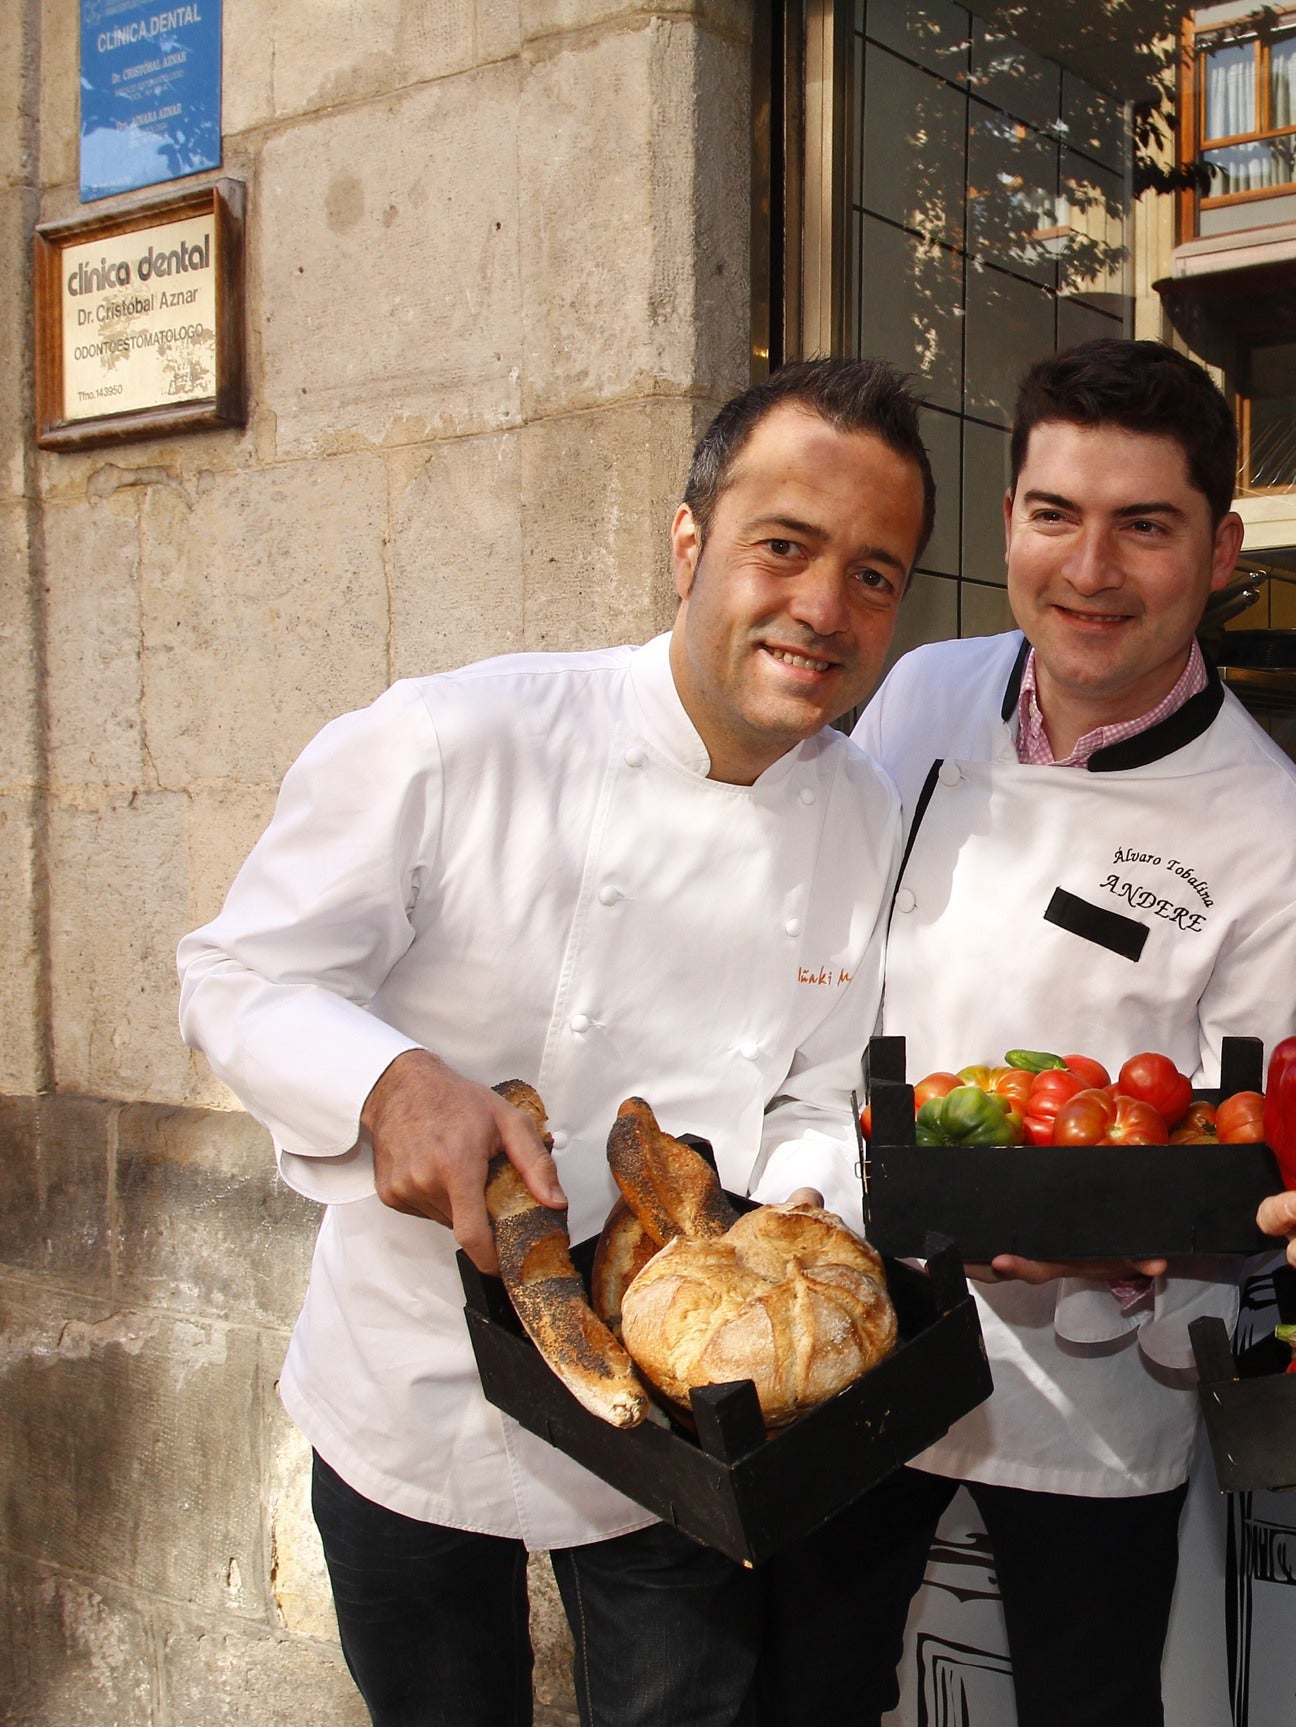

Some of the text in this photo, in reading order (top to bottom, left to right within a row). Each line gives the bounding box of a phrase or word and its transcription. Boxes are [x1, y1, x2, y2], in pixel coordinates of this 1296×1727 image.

[150, 4, 202, 36] DENTAL
[67, 234, 210, 297] clínica dental
[77, 287, 199, 326] Dr. Cristóbal Aznar
[73, 323, 203, 361] ODONTOESTOMATOLOGO
[1112, 846, 1215, 908] Álvaro Tobalina
[1099, 874, 1207, 933] ANDERE
